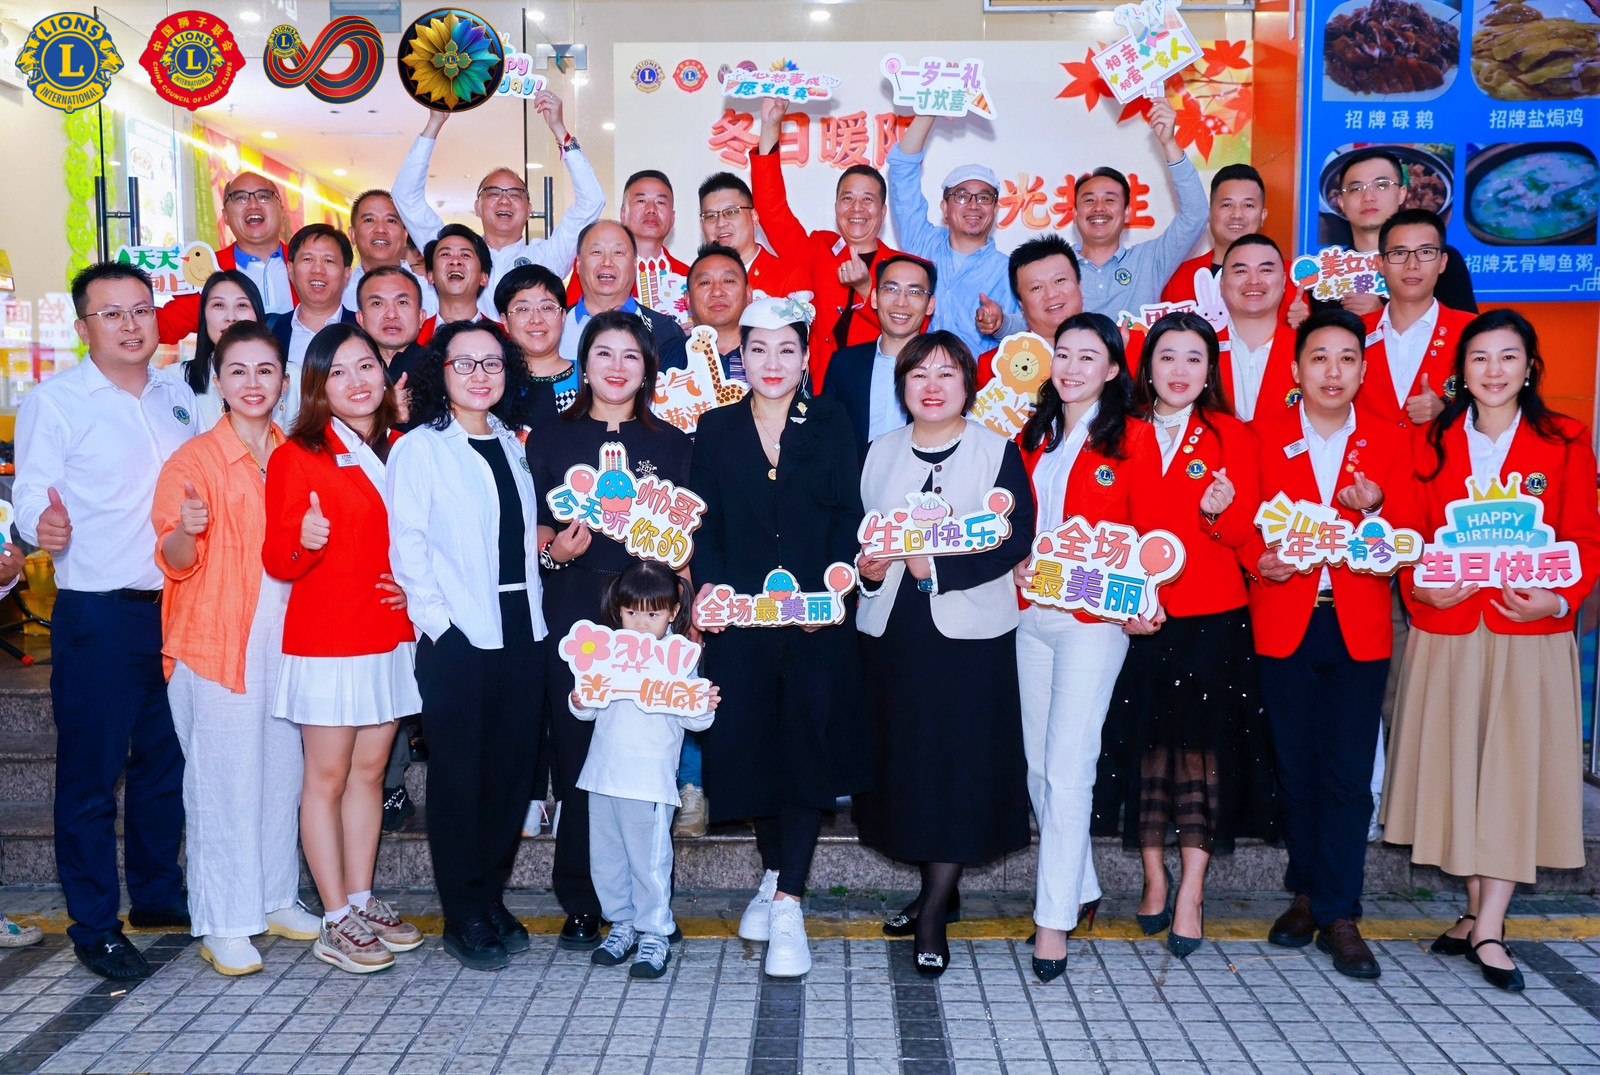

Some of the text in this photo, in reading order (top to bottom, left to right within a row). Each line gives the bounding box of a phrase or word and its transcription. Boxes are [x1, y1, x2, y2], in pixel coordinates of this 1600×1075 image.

[505, 57, 529, 76] py
[1104, 43, 1139, 71] 相亲
[644, 70, 653, 82] L
[752, 72, 820, 87] 心想事成
[900, 61, 981, 89] 一岁一礼
[734, 81, 809, 100] 愿望成真
[899, 88, 967, 112] 一寸欢喜
[1345, 109, 1434, 130] 招牌碌鹅
[1489, 107, 1584, 129] 招牌盐焗鸡
[133, 249, 179, 270] 天天
[1464, 253, 1593, 273] 招牌无骨鲫鱼粥
[971, 383, 1008, 419] 快乐
[635, 480, 701, 530] 帅哥
[1467, 511, 1524, 528] HAPPY
[863, 513, 997, 554] 生日快乐
[1054, 522, 1132, 569] 全场
[1284, 521, 1415, 564] 年年有今日
[1455, 528, 1536, 543] BIRTHDAY
[1421, 550, 1573, 583] 生日快乐
[1027, 559, 1146, 616] 最美丽
[700, 596, 832, 624] 全场最美丽
[611, 634, 696, 676] 小花
